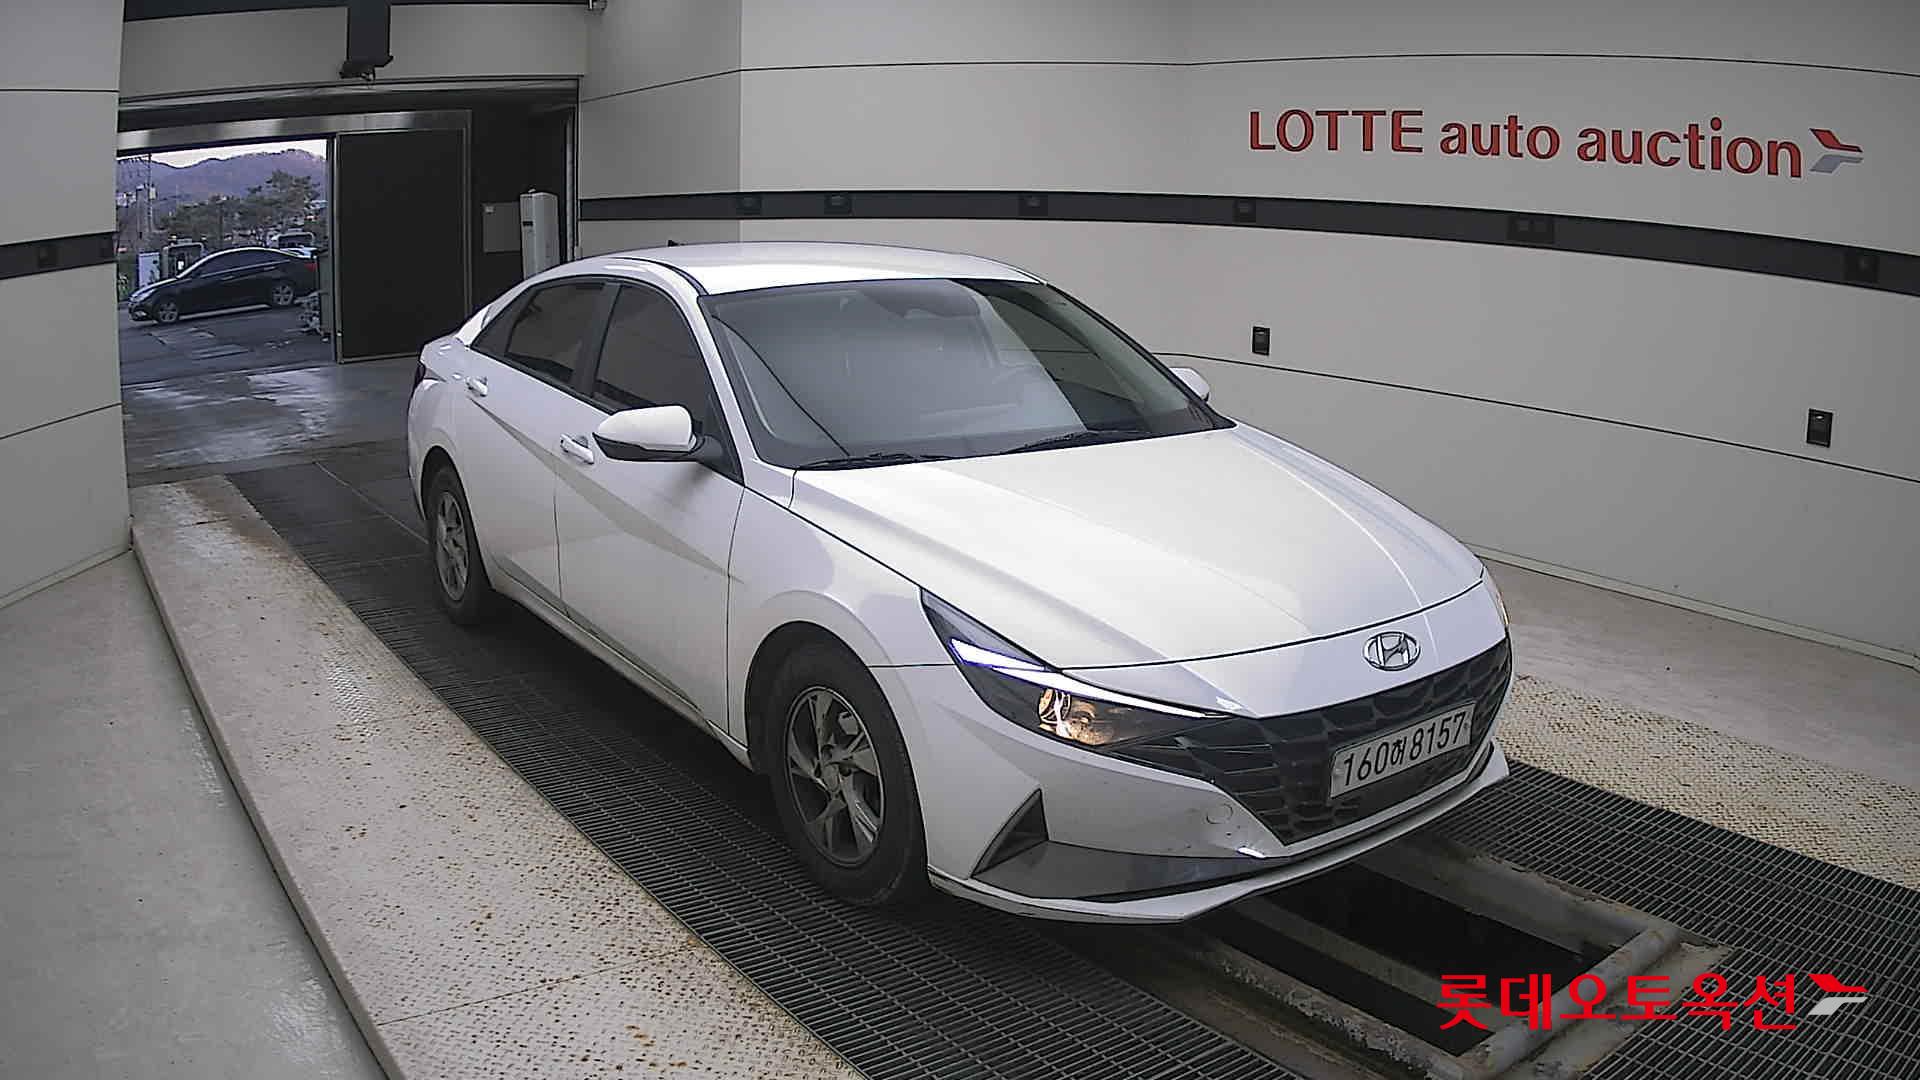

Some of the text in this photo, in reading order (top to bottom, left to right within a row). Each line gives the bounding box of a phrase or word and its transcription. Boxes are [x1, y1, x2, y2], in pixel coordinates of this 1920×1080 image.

[1249, 110, 1802, 177] LOTTE auto auction
